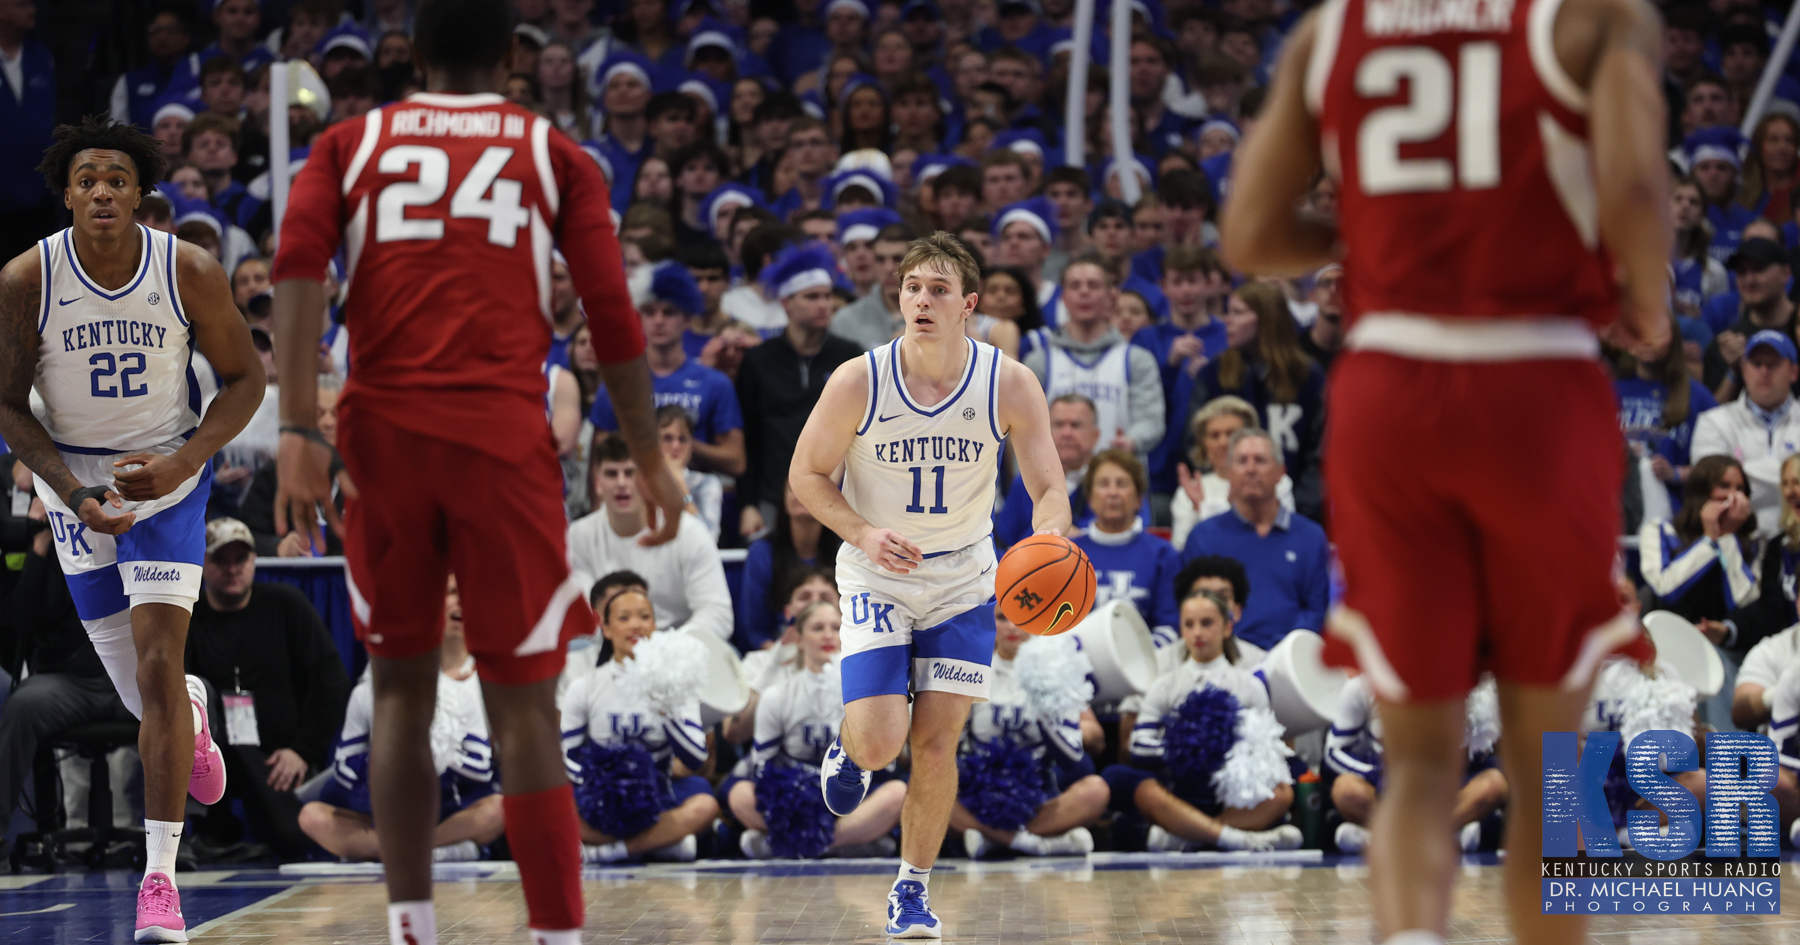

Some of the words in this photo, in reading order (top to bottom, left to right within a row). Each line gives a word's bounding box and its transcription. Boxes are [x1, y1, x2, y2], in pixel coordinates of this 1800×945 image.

[391, 108, 501, 138] RICHMOND
[503, 114, 526, 140] III
[1356, 42, 1502, 195] 21
[376, 144, 530, 249] 24
[62, 320, 167, 352] KENTUCKY
[88, 352, 148, 398] 22
[875, 436, 984, 463] KENTUCKY
[906, 465, 948, 514] 11
[49, 511, 93, 556] UK
[133, 565, 181, 582] Wildcats
[851, 592, 895, 633] UK
[933, 661, 984, 684] Wildcats
